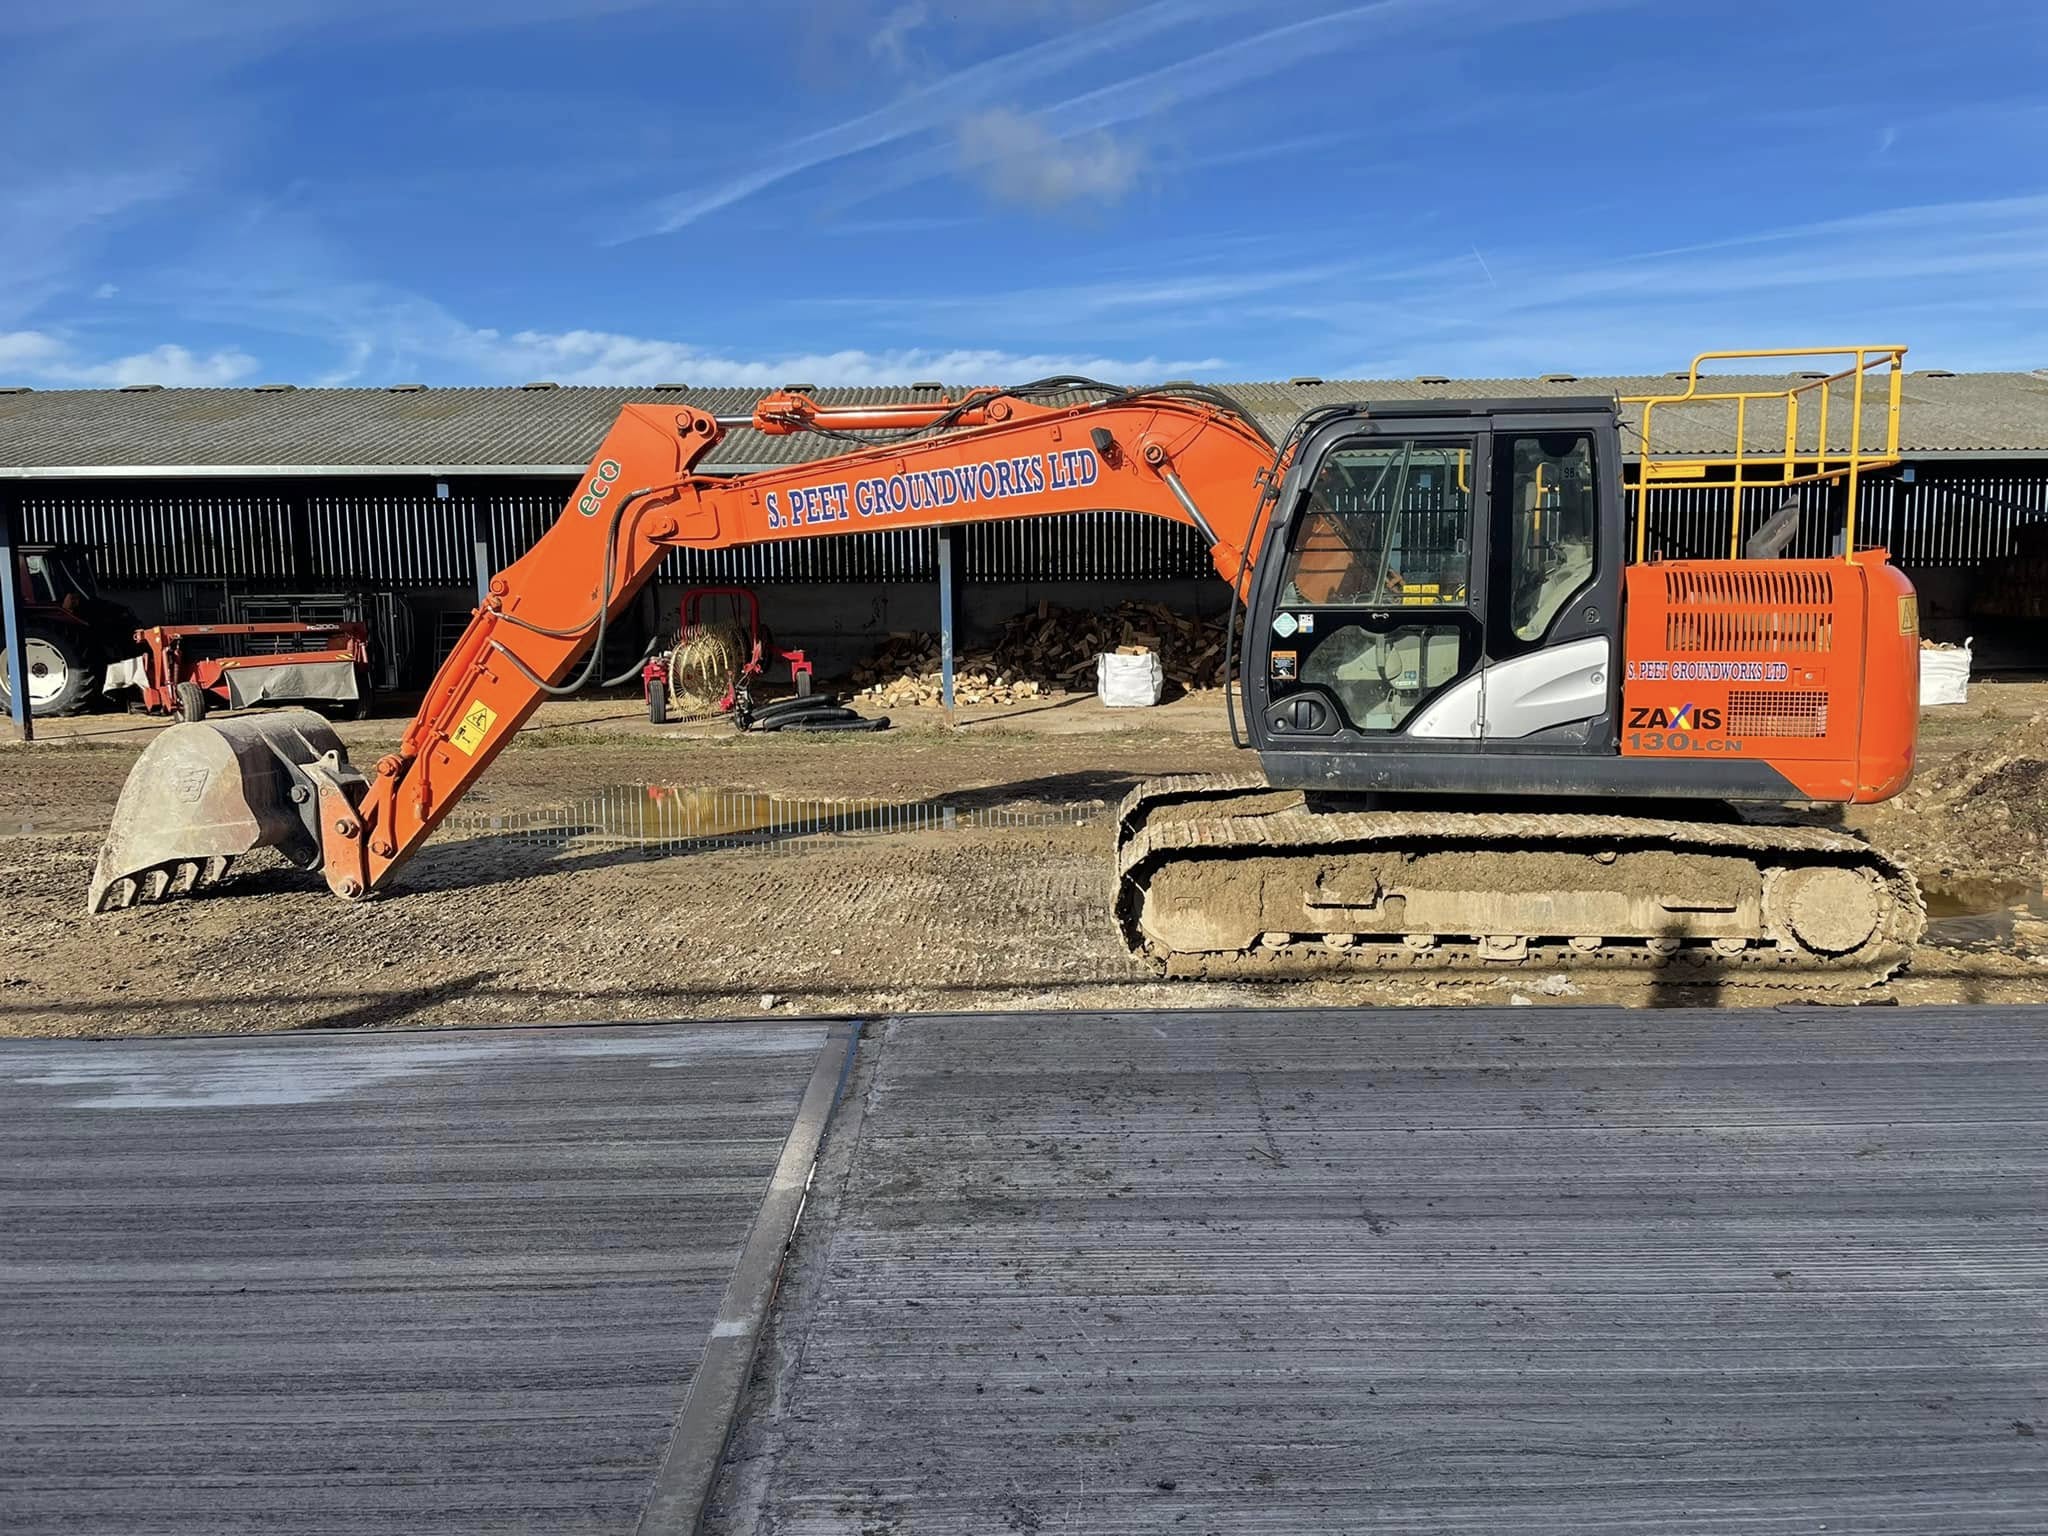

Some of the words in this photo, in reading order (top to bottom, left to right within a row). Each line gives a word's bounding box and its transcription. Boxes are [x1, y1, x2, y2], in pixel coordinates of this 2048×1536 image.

[578, 458, 621, 517] eco
[766, 493, 787, 528] S.
[788, 482, 849, 525] PEET
[855, 455, 1045, 517] GROUNDWORKS
[1048, 448, 1098, 491] LTD
[1627, 661, 1638, 680] S.
[1639, 661, 1669, 681] PEET
[1671, 661, 1763, 681] GROUNDWORKS
[1764, 662, 1788, 681] LTD
[1628, 703, 1722, 730] ZAXIS
